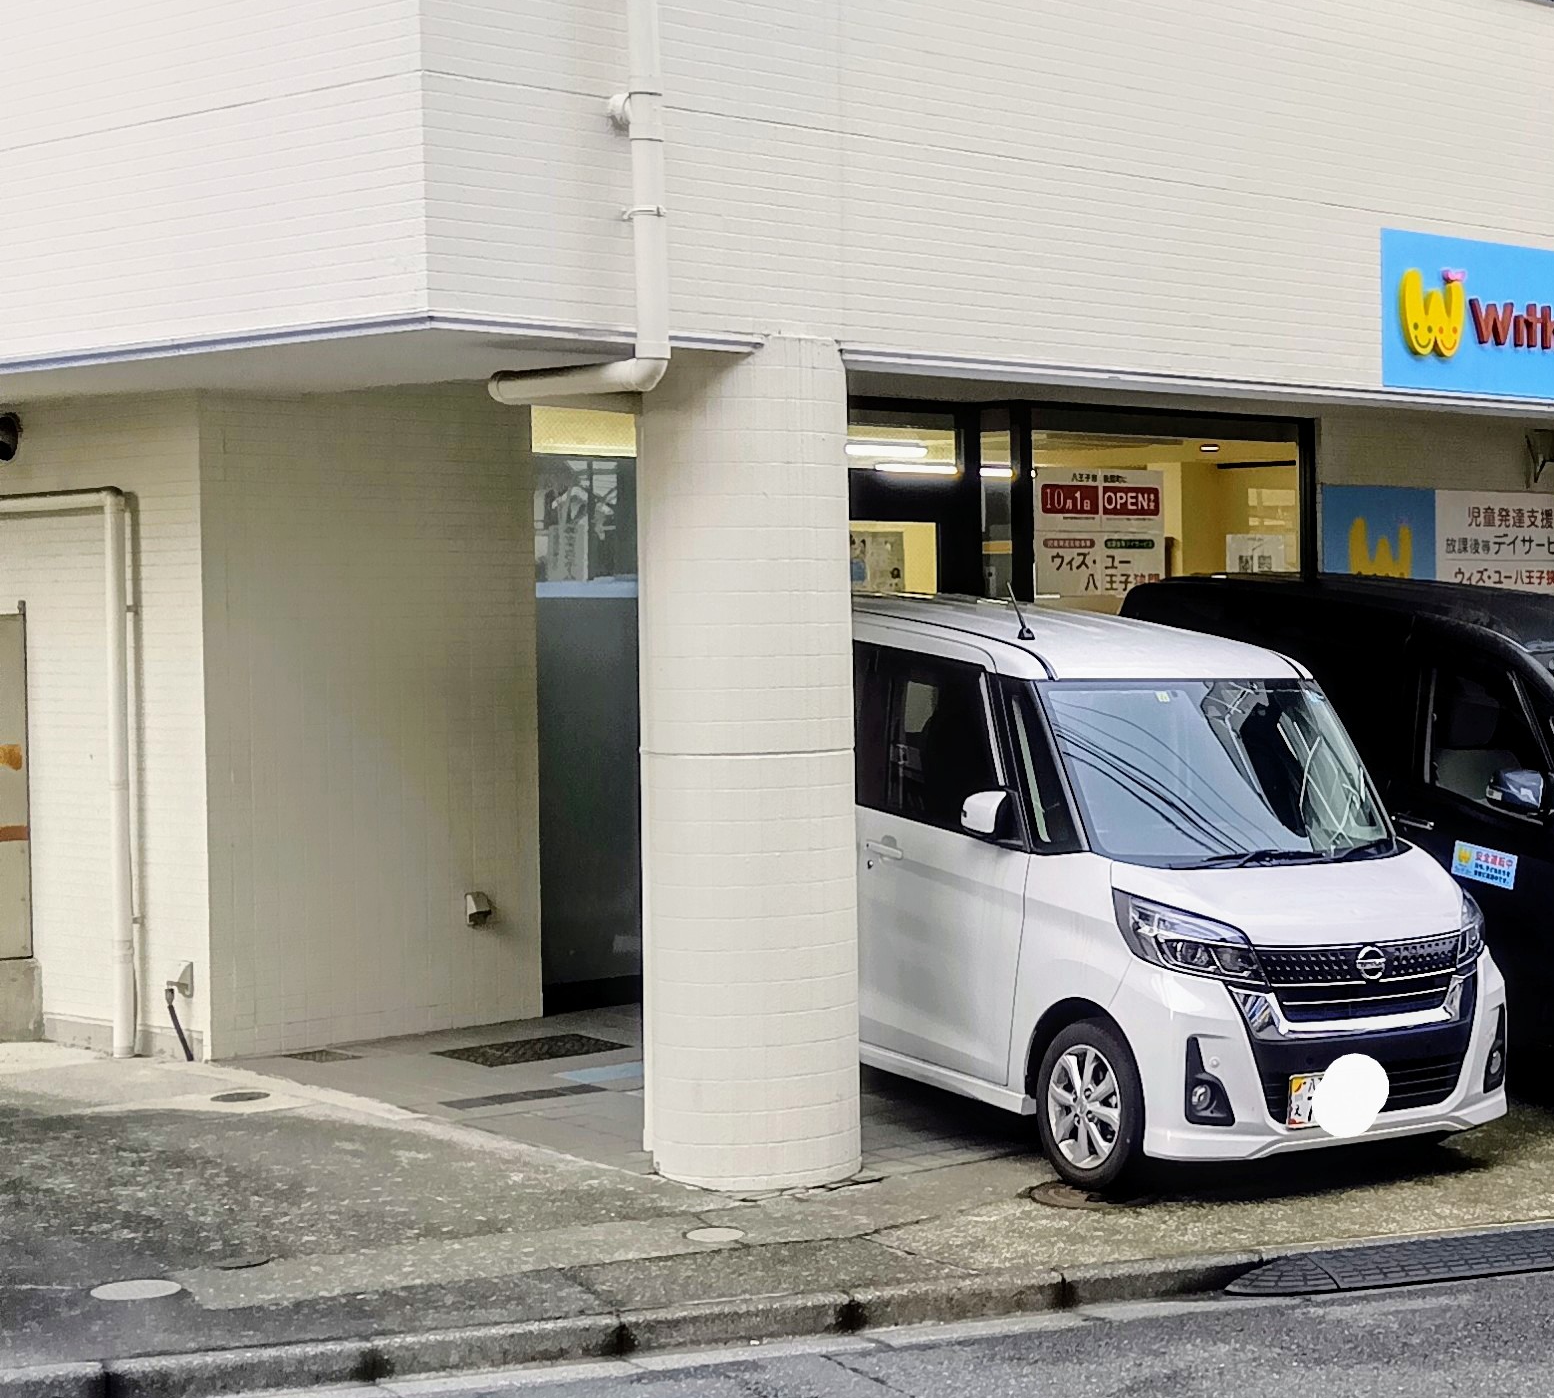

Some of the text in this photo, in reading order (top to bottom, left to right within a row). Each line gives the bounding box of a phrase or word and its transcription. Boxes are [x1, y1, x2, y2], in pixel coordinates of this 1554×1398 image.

[1043, 488, 1092, 511] 10月1日
[1104, 491, 1148, 510] OPEN
[1467, 505, 1554, 530] 児童発達支援
